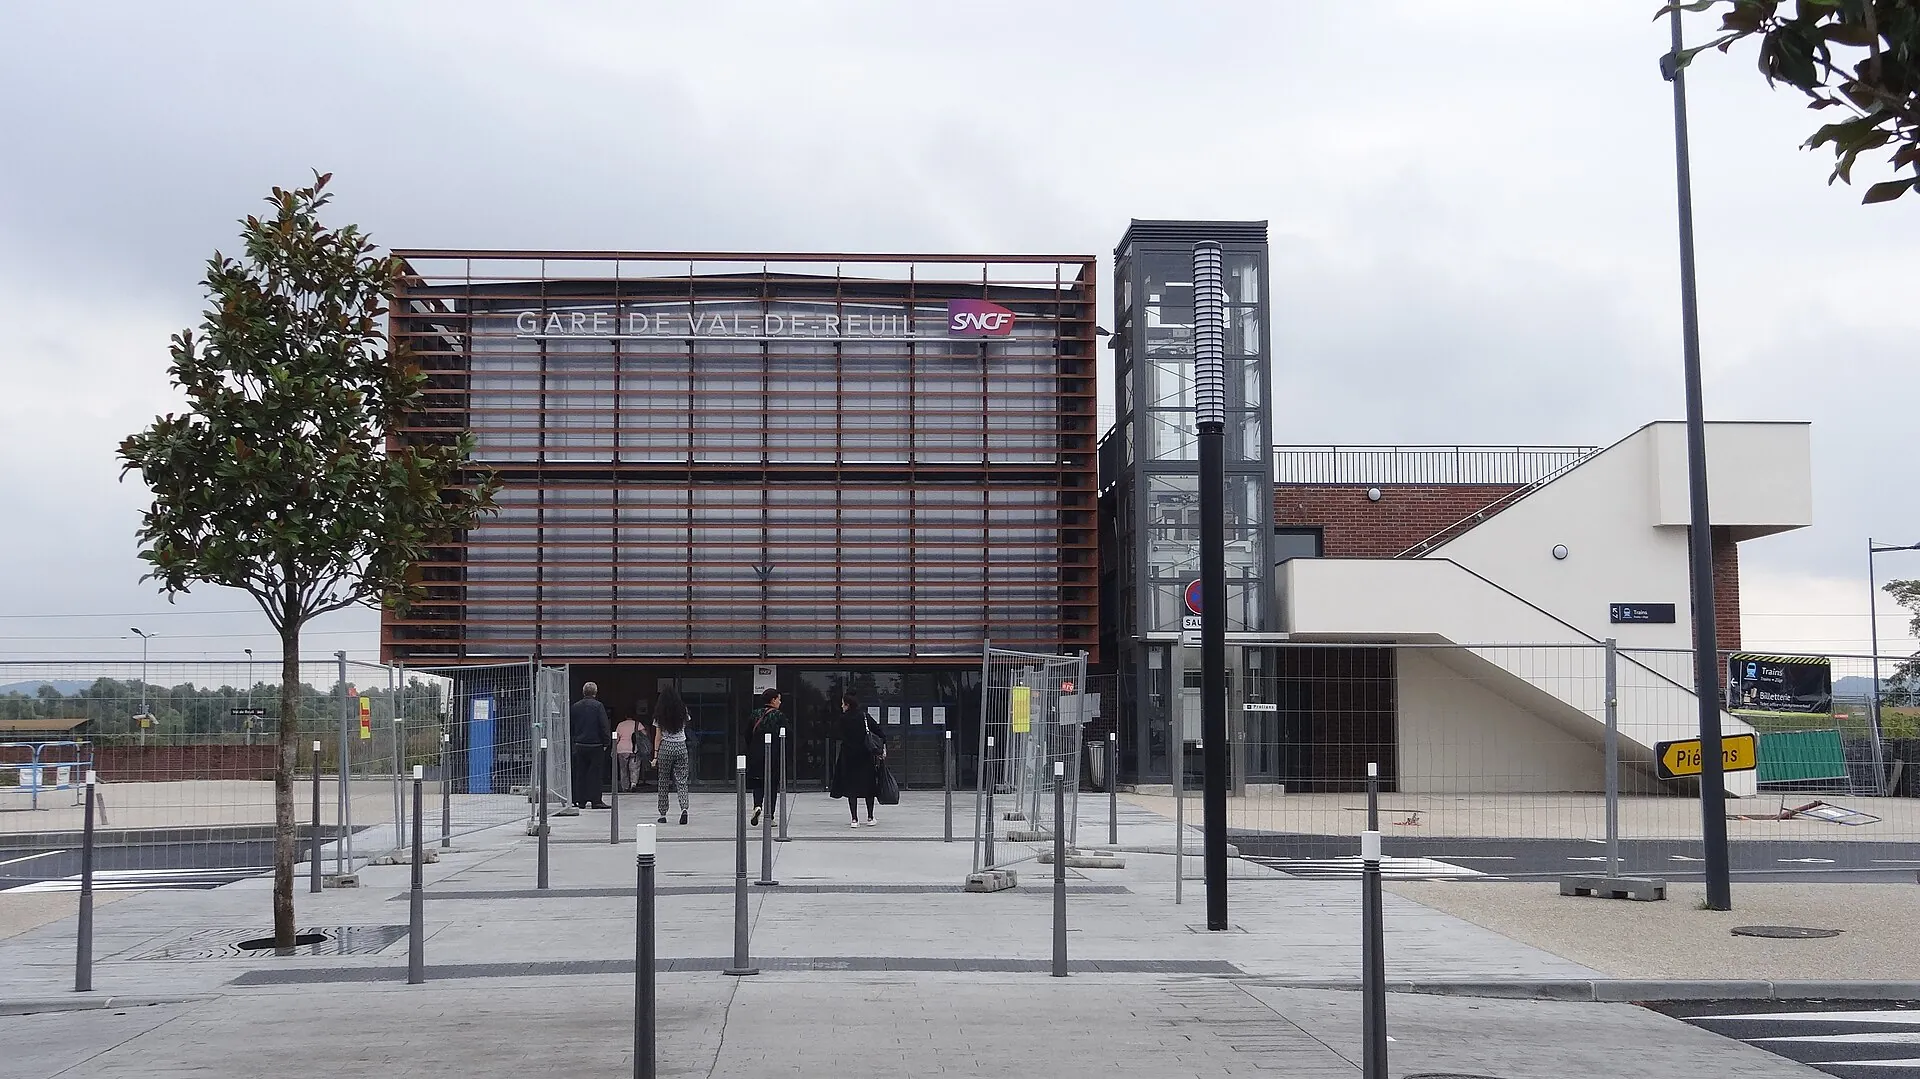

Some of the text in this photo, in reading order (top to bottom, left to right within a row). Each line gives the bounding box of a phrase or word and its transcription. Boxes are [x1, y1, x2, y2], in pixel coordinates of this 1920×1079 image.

[516, 311, 916, 335] GARE DE VAL-DE-REUIL
[951, 313, 1012, 330] SNCF
[1761, 667, 1783, 676] Trains
[1760, 691, 1791, 701] Billetterie
[1676, 748, 1738, 768] Piéns
